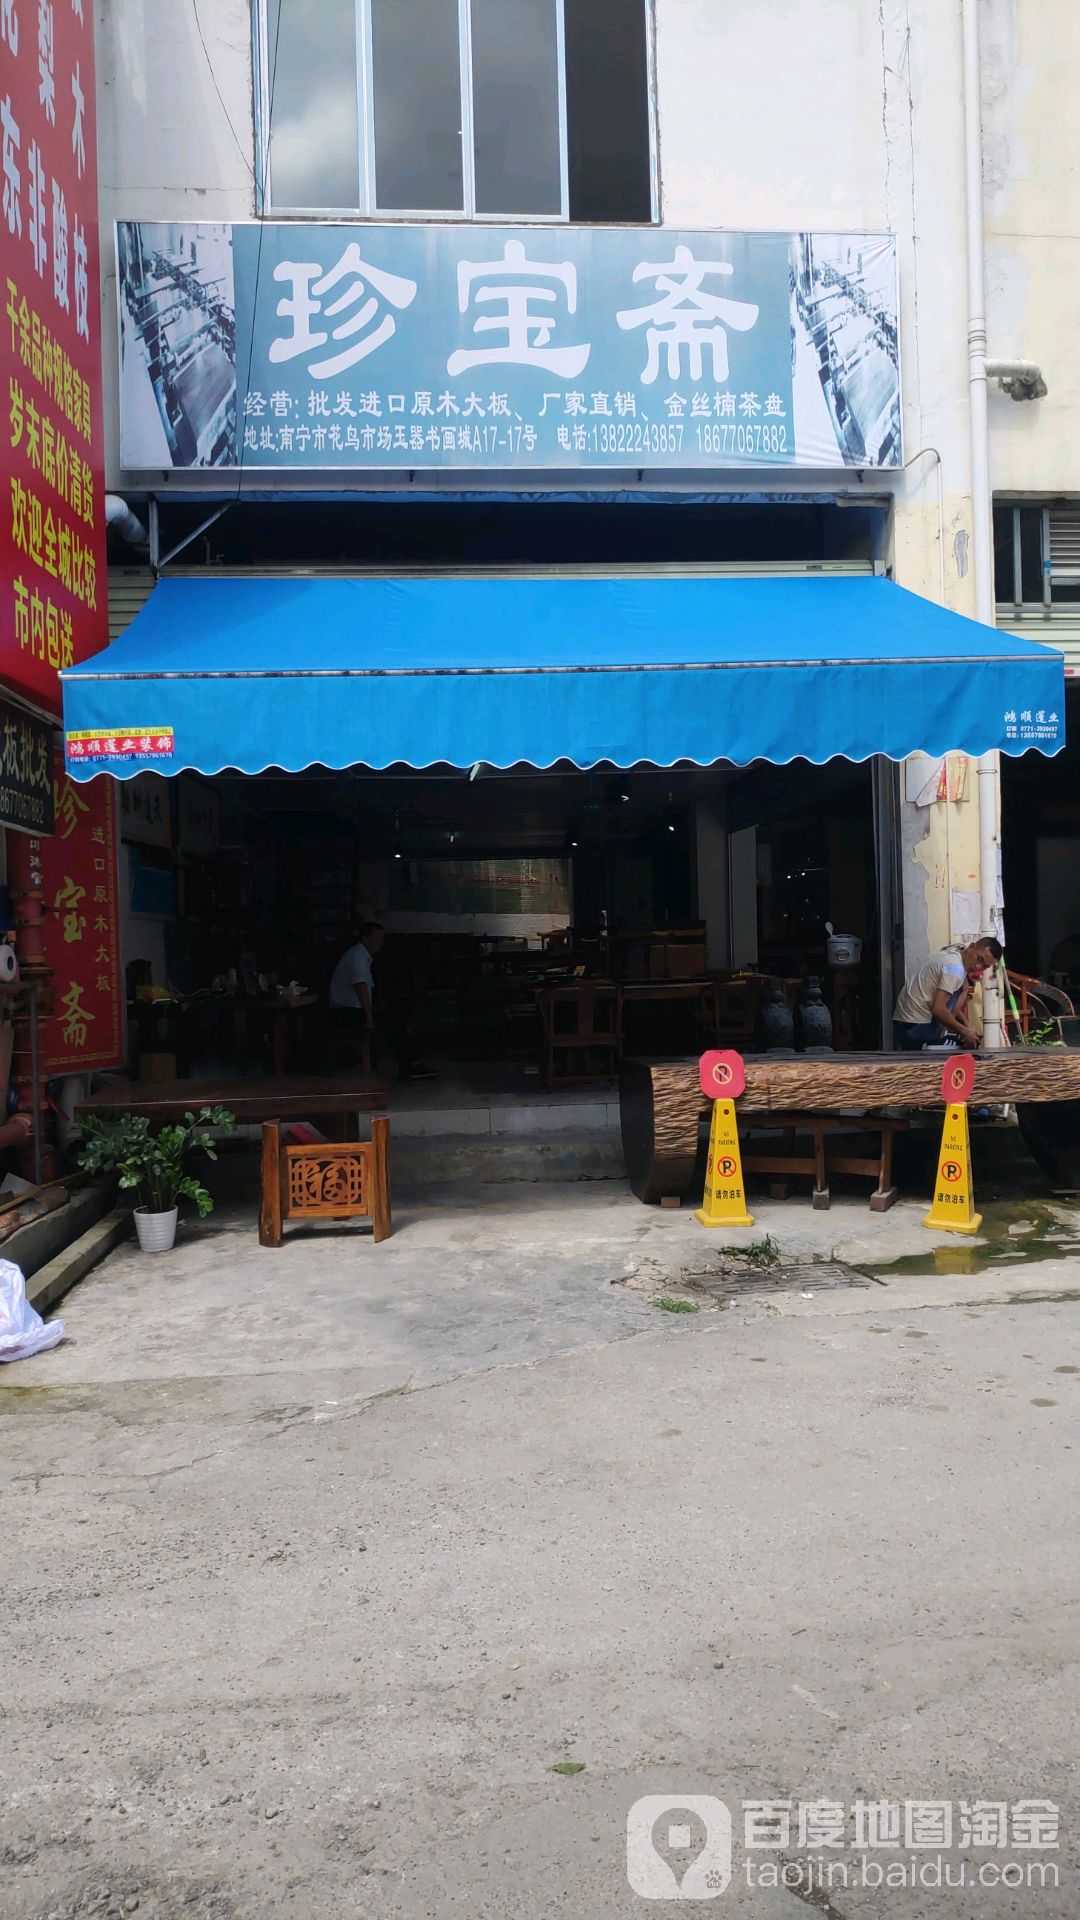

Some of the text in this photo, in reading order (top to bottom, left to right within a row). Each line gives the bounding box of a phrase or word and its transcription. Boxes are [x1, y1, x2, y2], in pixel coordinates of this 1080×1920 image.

[268, 239, 759, 384] 珍宝斋
[10, 376, 94, 530] 岁末底价清货
[696, 424, 787, 453] 18677067882
[11, 477, 96, 612] 欢迎全城比较
[13, 575, 73, 669] 市内包送
[0, 715, 51, 795] 板批发
[53, 777, 95, 1047] 珍宝斋
[90, 827, 111, 992] 进口原木大板
[715, 1189, 742, 1199] 请勿泊车
[937, 1192, 966, 1205] 请勿泊车
